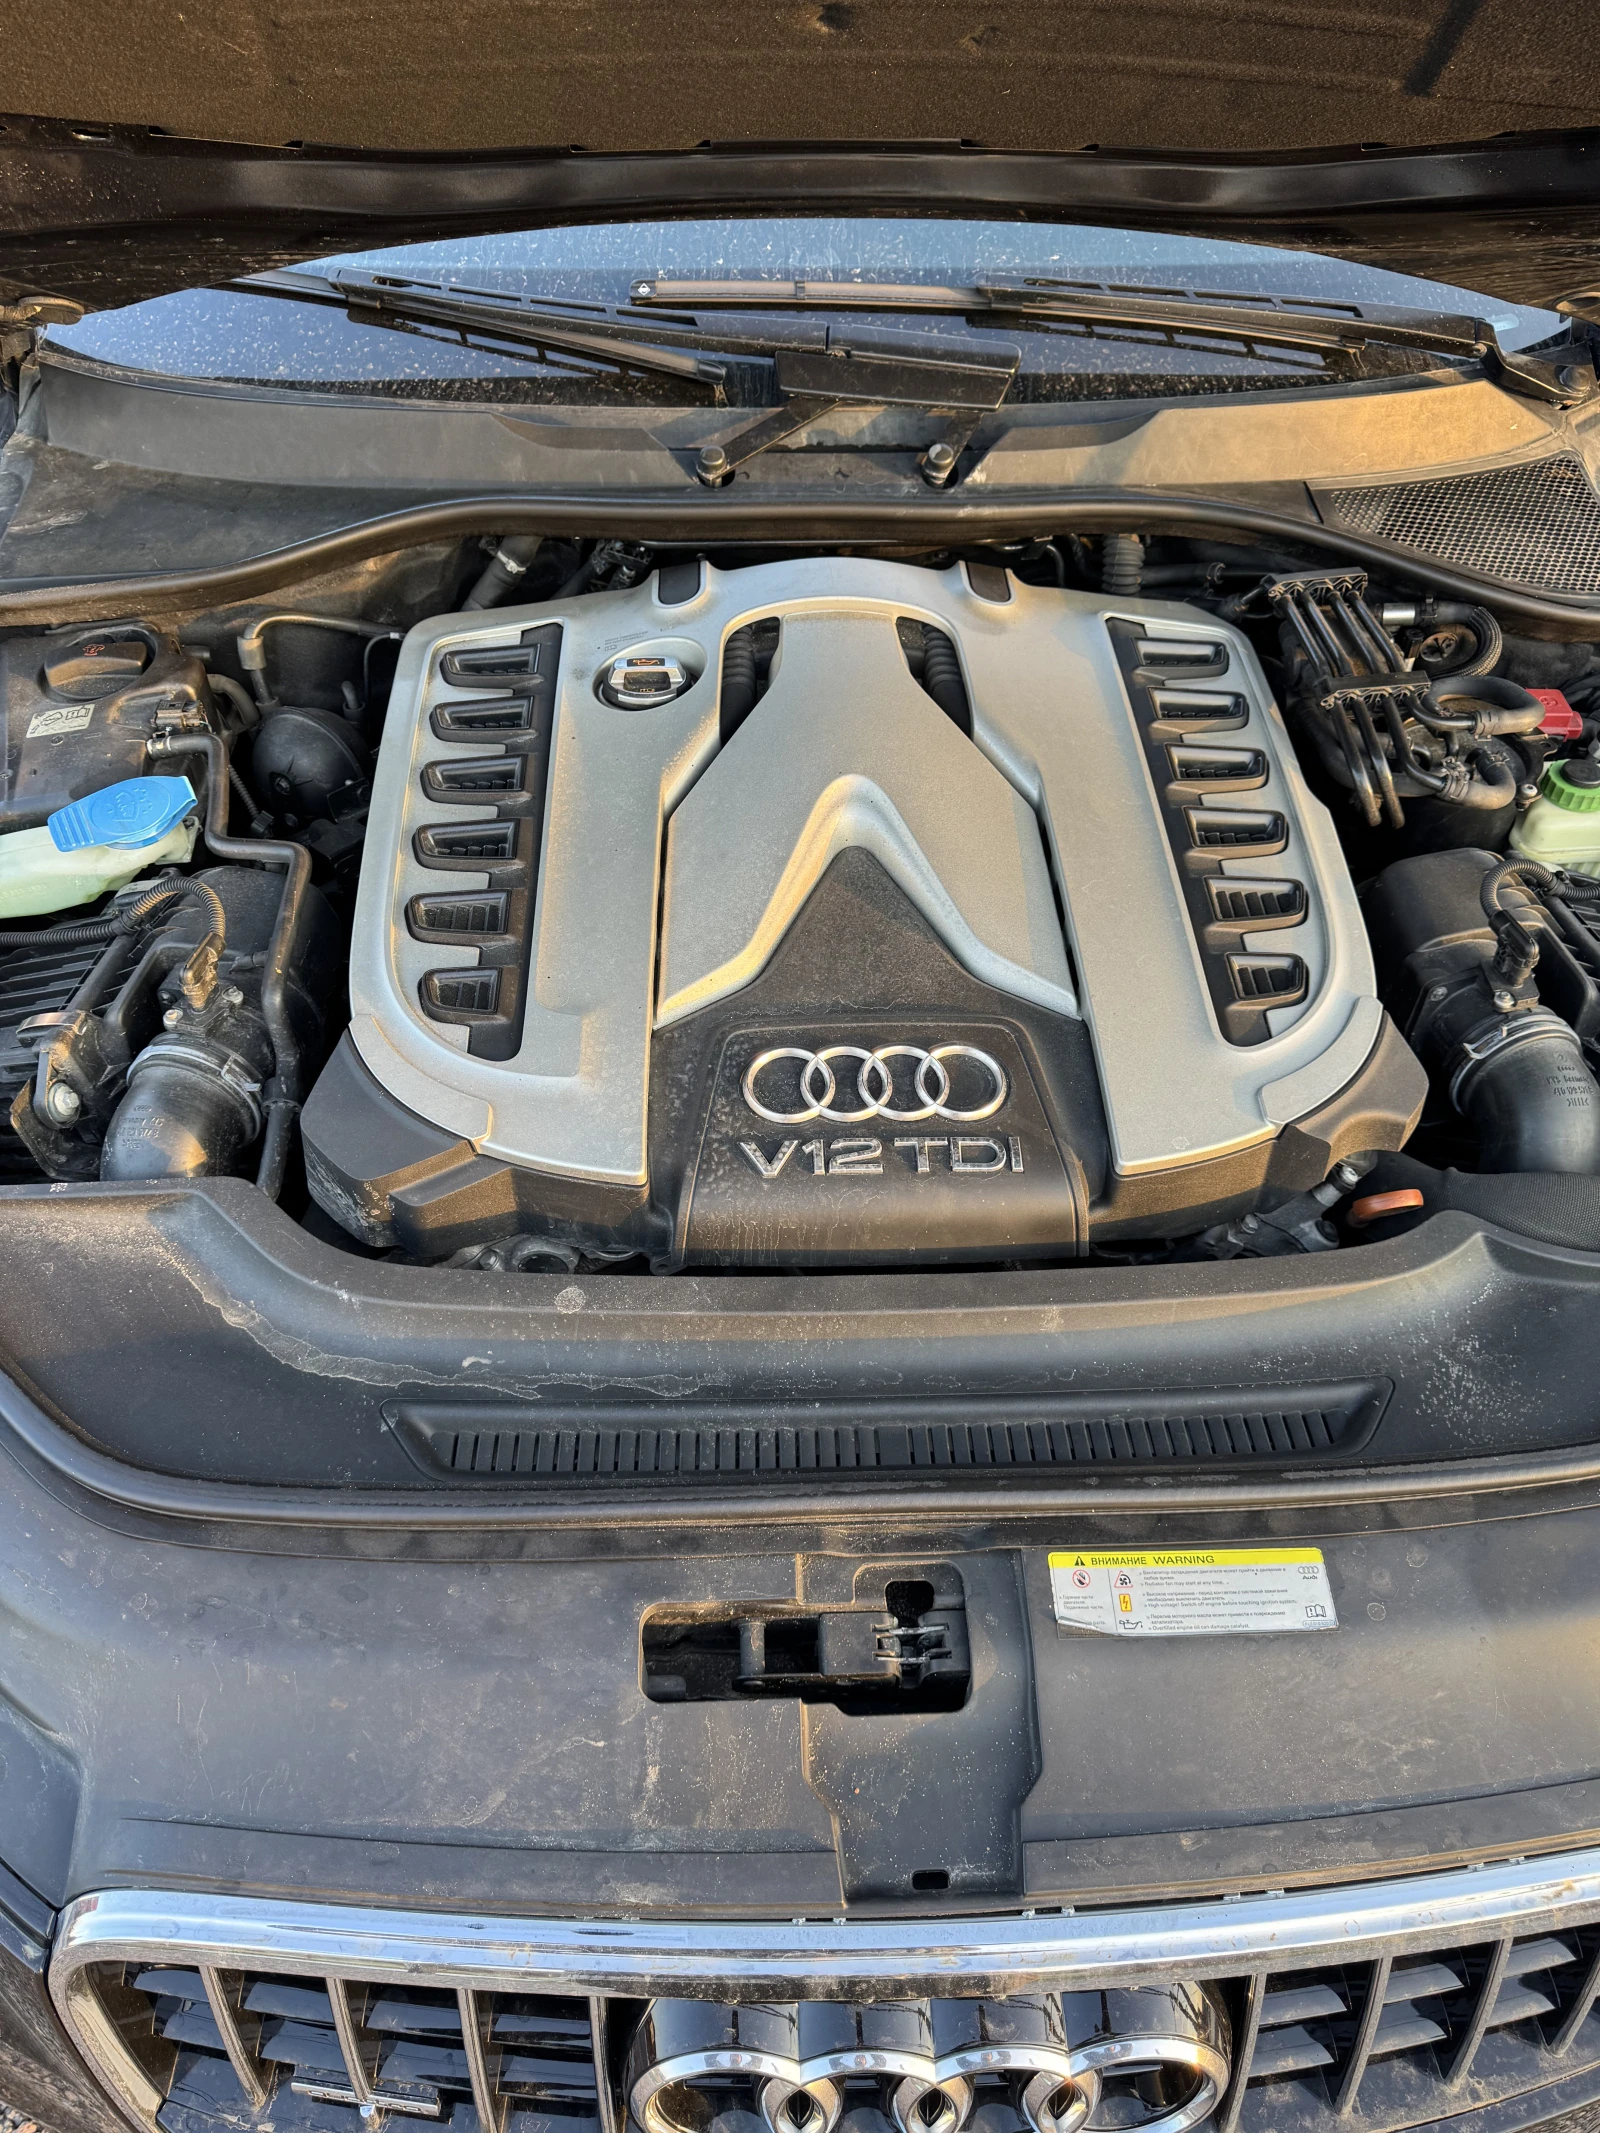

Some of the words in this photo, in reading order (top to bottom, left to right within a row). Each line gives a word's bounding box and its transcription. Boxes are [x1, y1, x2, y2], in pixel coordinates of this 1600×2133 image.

[739, 1137, 884, 1178] V12
[894, 1136, 1024, 1173] TDI
[1091, 1557, 1147, 1565] ВНИМАНИЕ
[1153, 1555, 1215, 1564] WARNING
